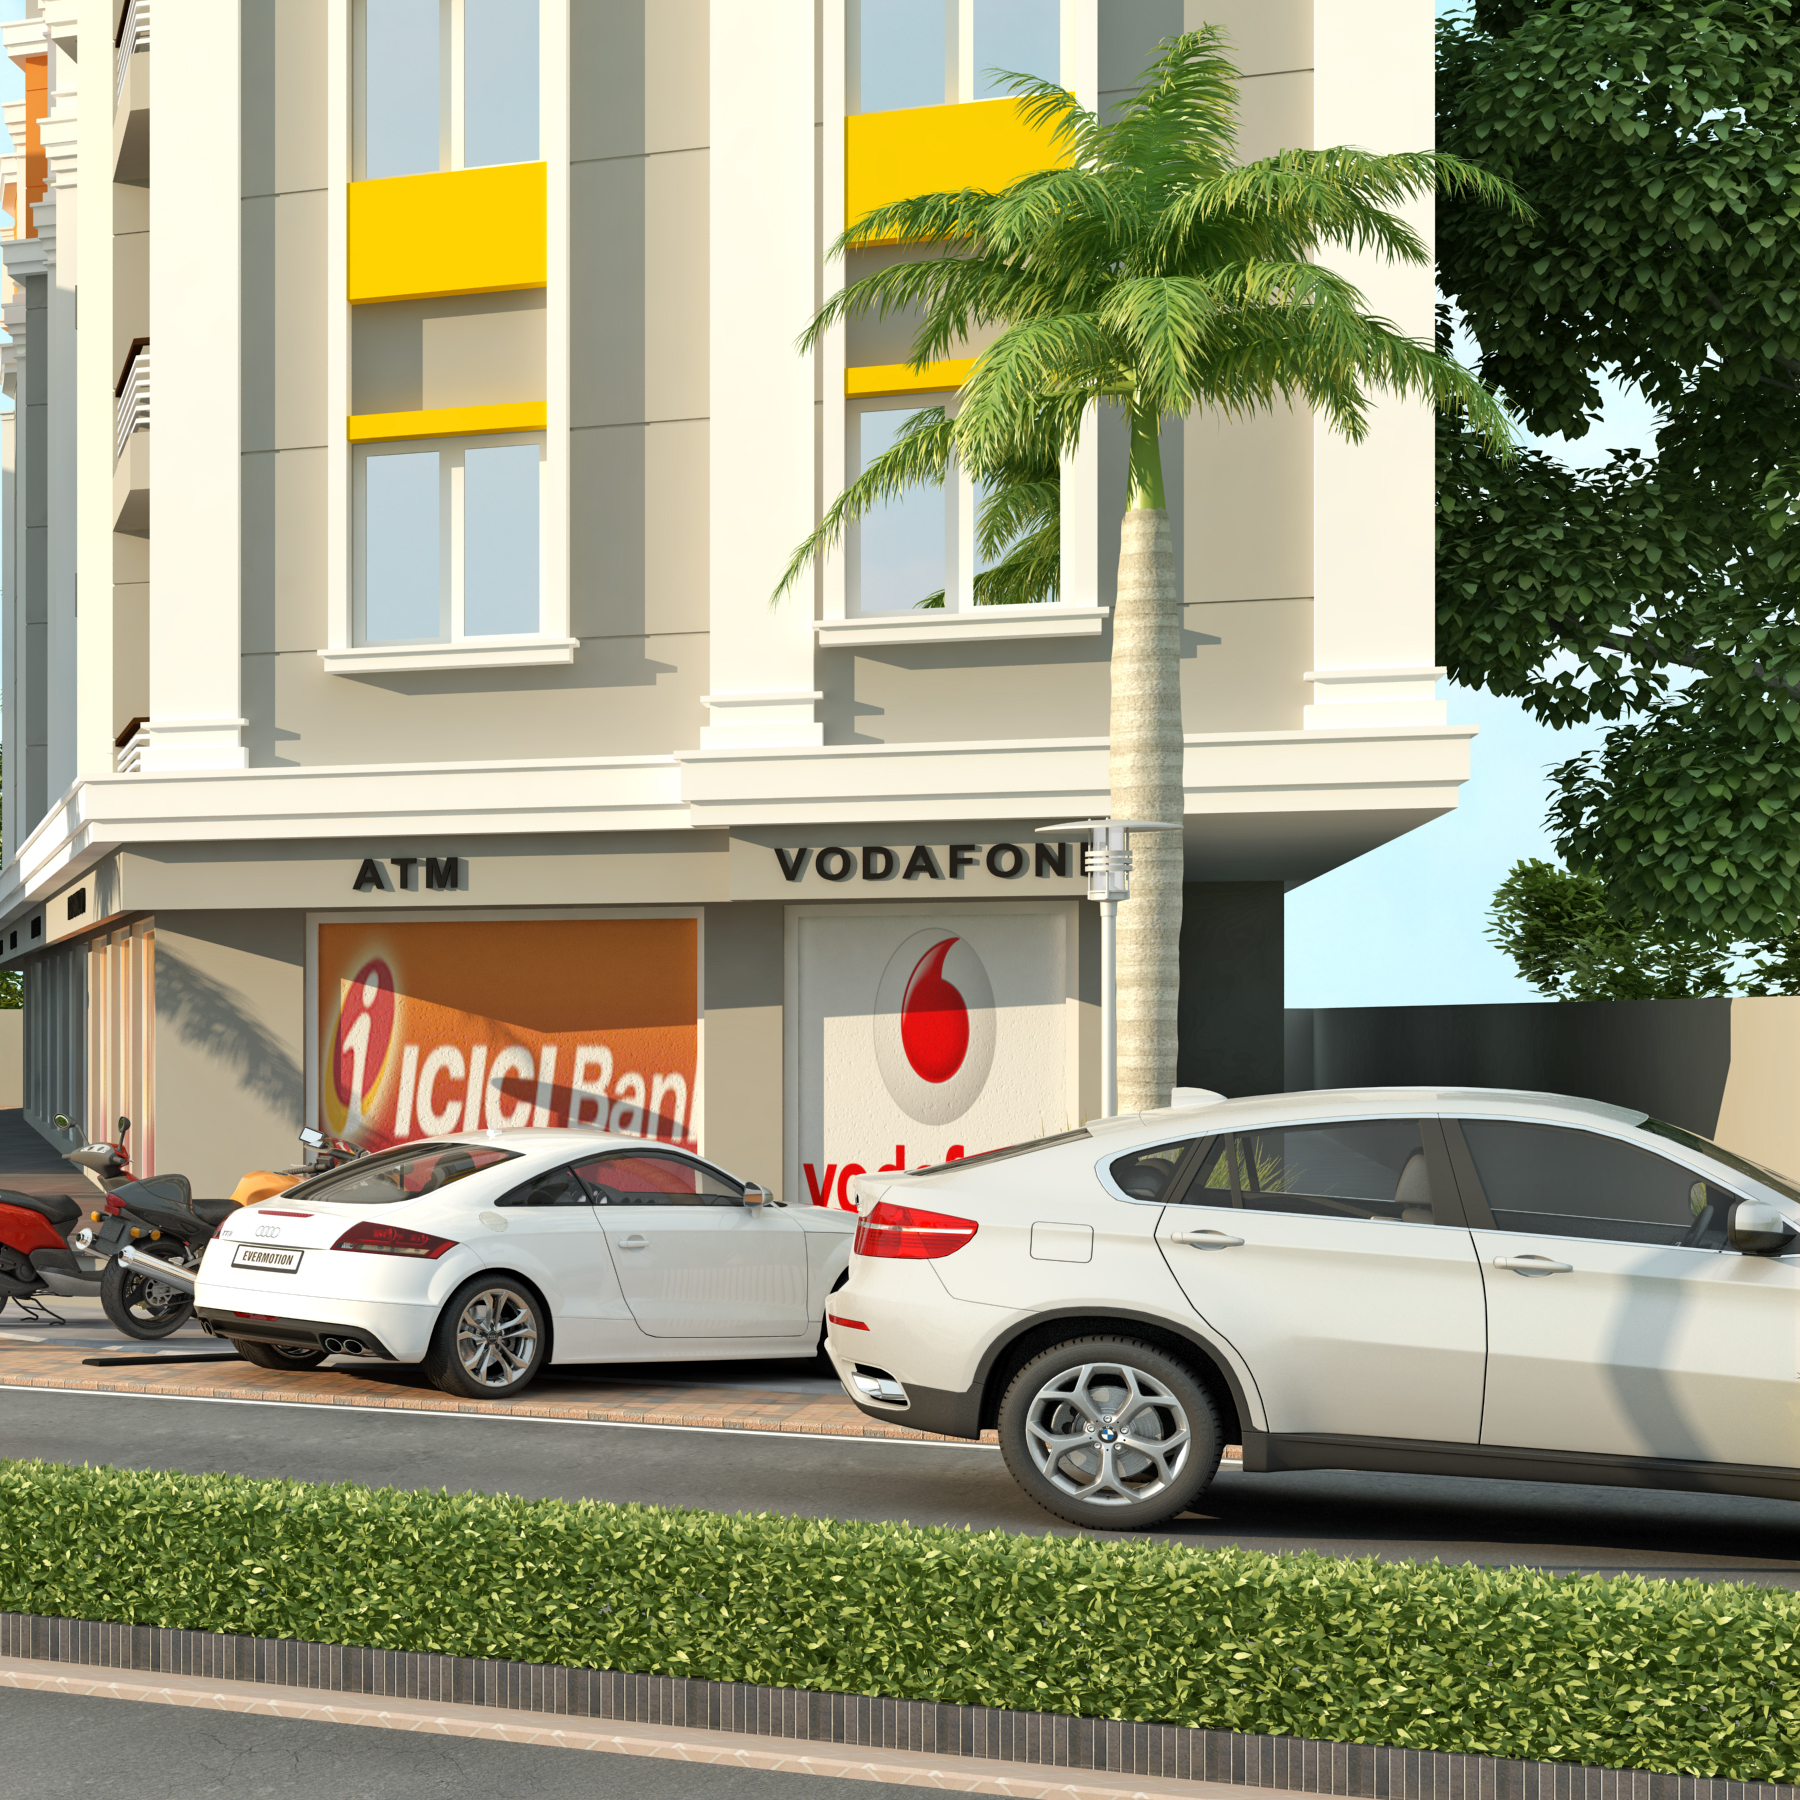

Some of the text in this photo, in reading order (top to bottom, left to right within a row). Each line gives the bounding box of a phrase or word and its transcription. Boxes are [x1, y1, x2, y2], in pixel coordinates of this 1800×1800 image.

[352, 857, 459, 890] ATM
[393, 1043, 558, 1138] ICICI
[242, 1250, 294, 1266] EVERMOTION
